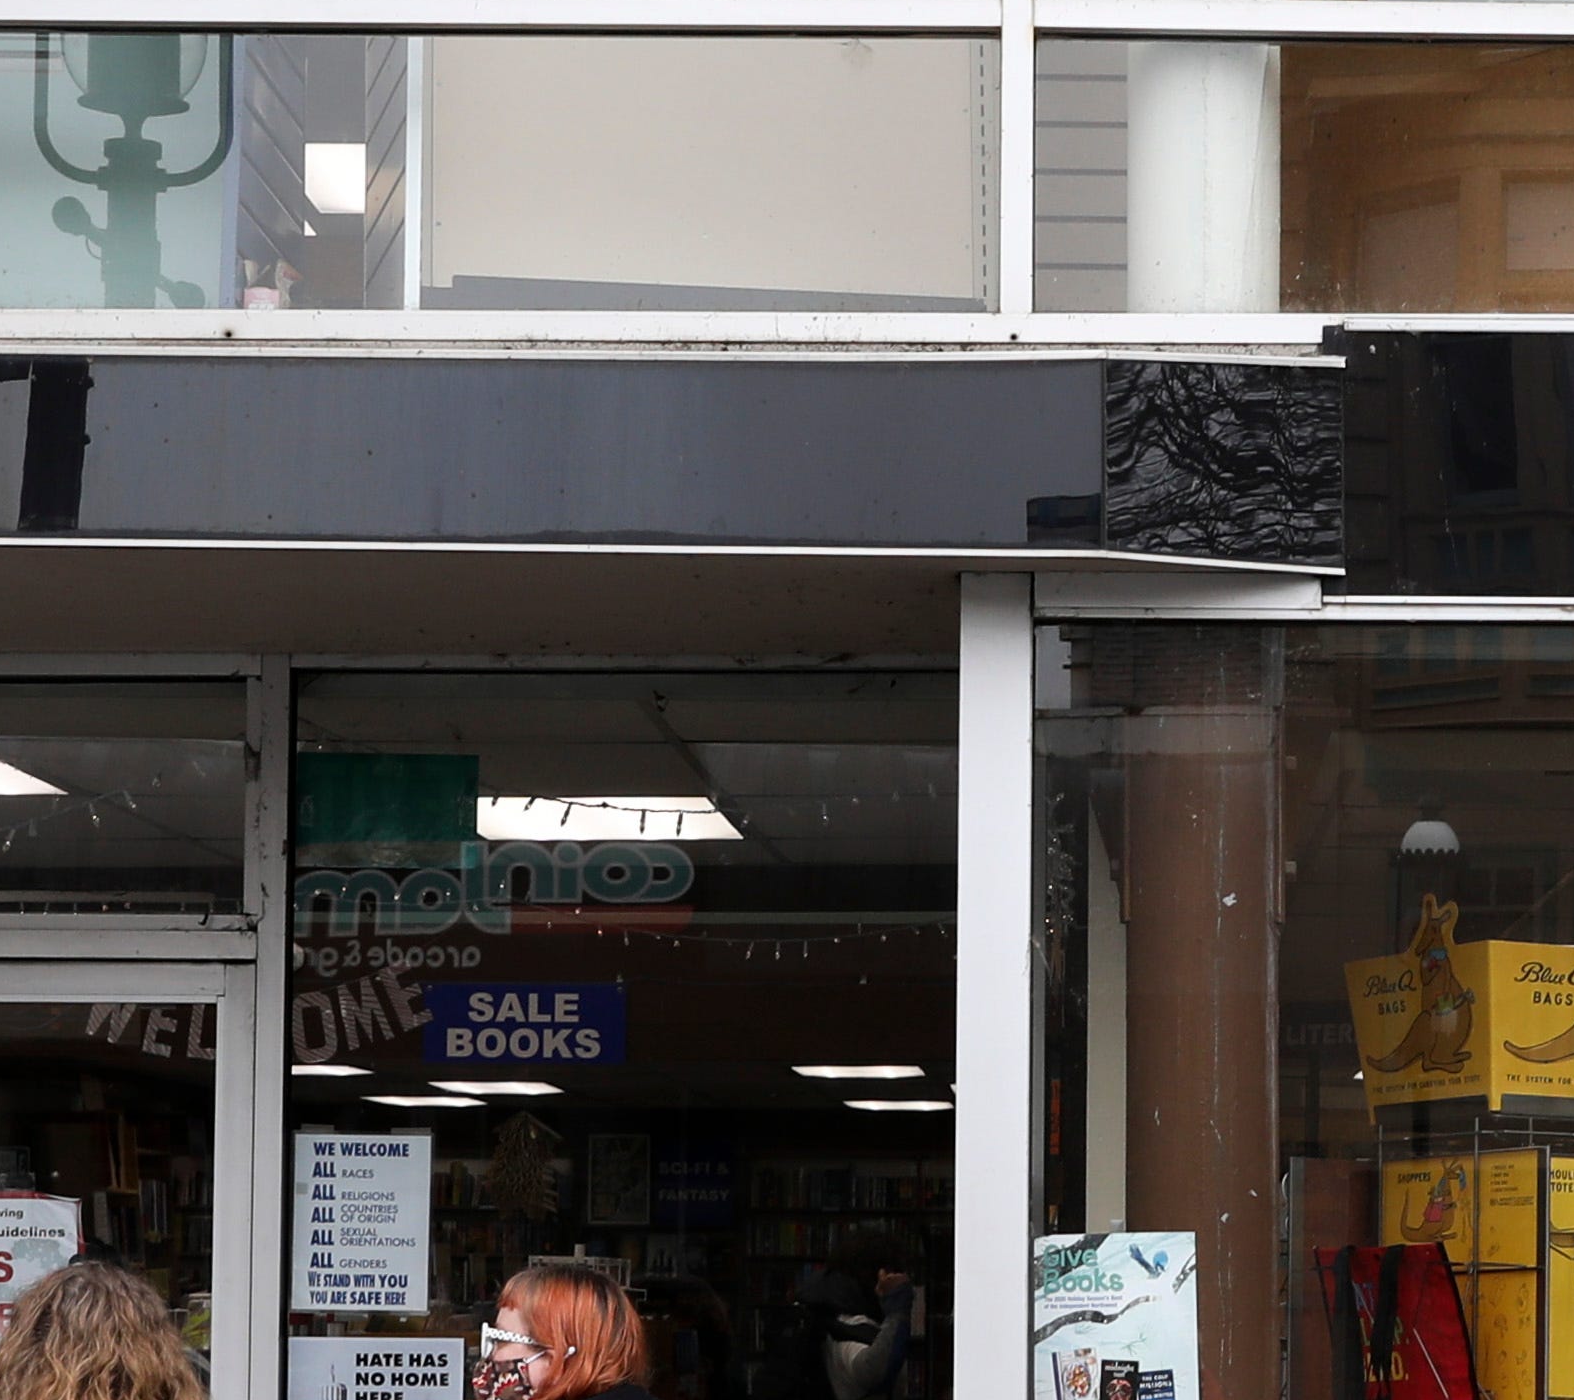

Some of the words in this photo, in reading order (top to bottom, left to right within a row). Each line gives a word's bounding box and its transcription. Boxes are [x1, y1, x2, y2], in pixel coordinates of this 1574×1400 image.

[1533, 991, 1574, 1006] BAGS
[467, 992, 581, 1025] SALE
[445, 1027, 602, 1060] BOOKS
[314, 1142, 335, 1156] WE
[341, 1143, 409, 1157] WELCOME
[312, 1162, 336, 1178] ALL
[342, 1169, 374, 1178] RACES
[312, 1184, 336, 1200] ALL
[341, 1192, 395, 1201] RELIGIONS
[311, 1207, 335, 1223] ALL
[341, 1204, 398, 1213] COUNTRIES
[358, 1214, 396, 1223] ORIGIN
[311, 1230, 334, 1245] ALL
[340, 1228, 378, 1237] SEXUAL
[340, 1238, 416, 1247] ORIENTATIONS
[310, 1252, 334, 1268] ALL
[339, 1259, 387, 1268] GENDERS
[324, 1274, 351, 1287] STAND
[354, 1275, 375, 1288] WITH
[378, 1275, 408, 1288] YOU
[1043, 1268, 1124, 1295] Books
[310, 1291, 327, 1304] YOU
[330, 1291, 347, 1304] ARE
[350, 1292, 382, 1305] SAFE
[385, 1292, 406, 1305] HERE
[356, 1353, 403, 1367] HATE
[409, 1354, 448, 1367] HAS
[355, 1373, 384, 1386] NO
[391, 1373, 449, 1386] HOME
